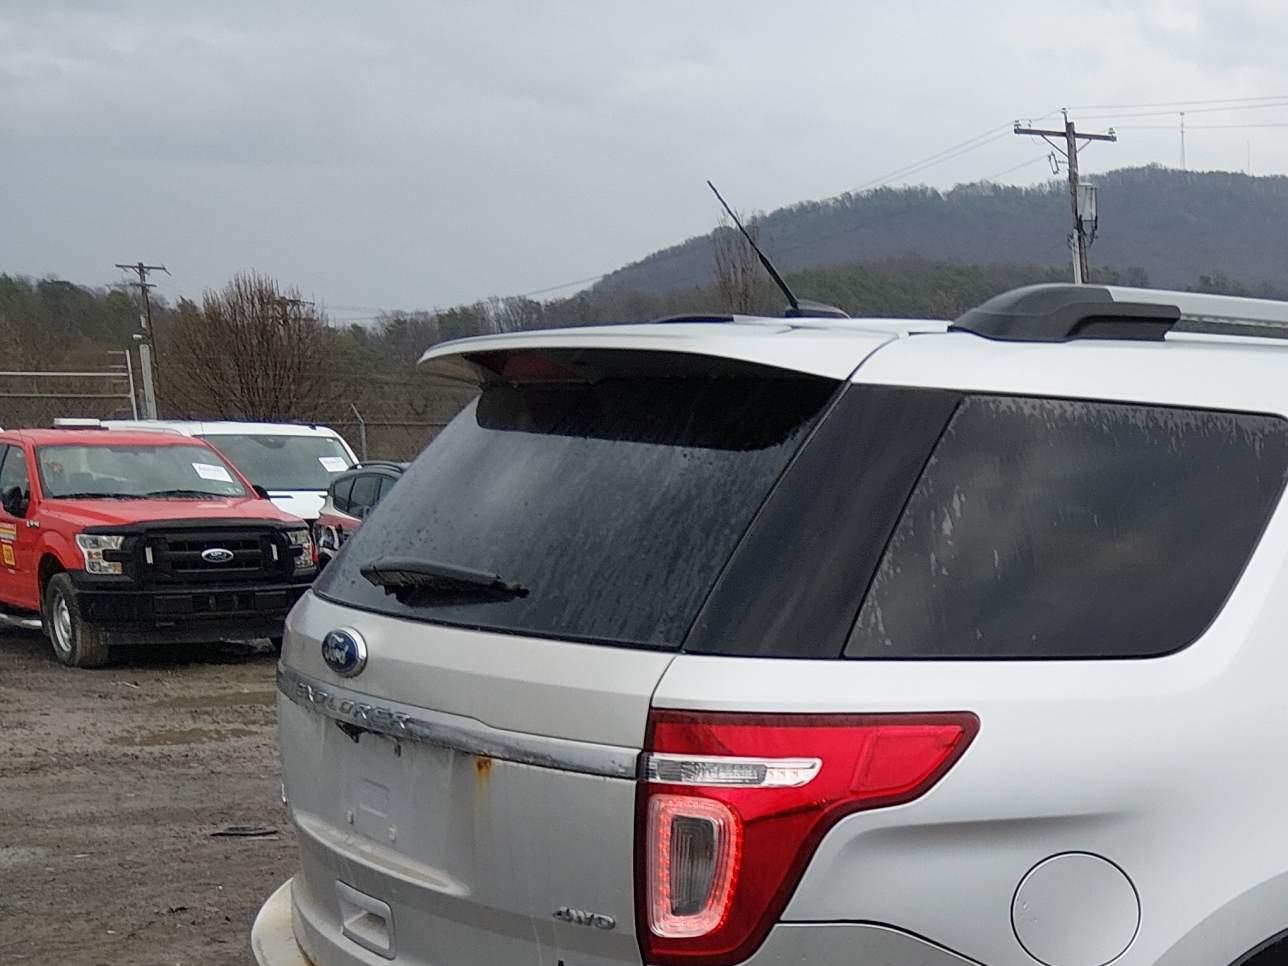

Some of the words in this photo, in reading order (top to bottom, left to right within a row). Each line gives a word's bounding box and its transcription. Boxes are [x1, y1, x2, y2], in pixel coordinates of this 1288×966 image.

[324, 632, 352, 667] Ford
[296, 682, 411, 729] EXPLORER
[552, 905, 617, 930] 4WD
